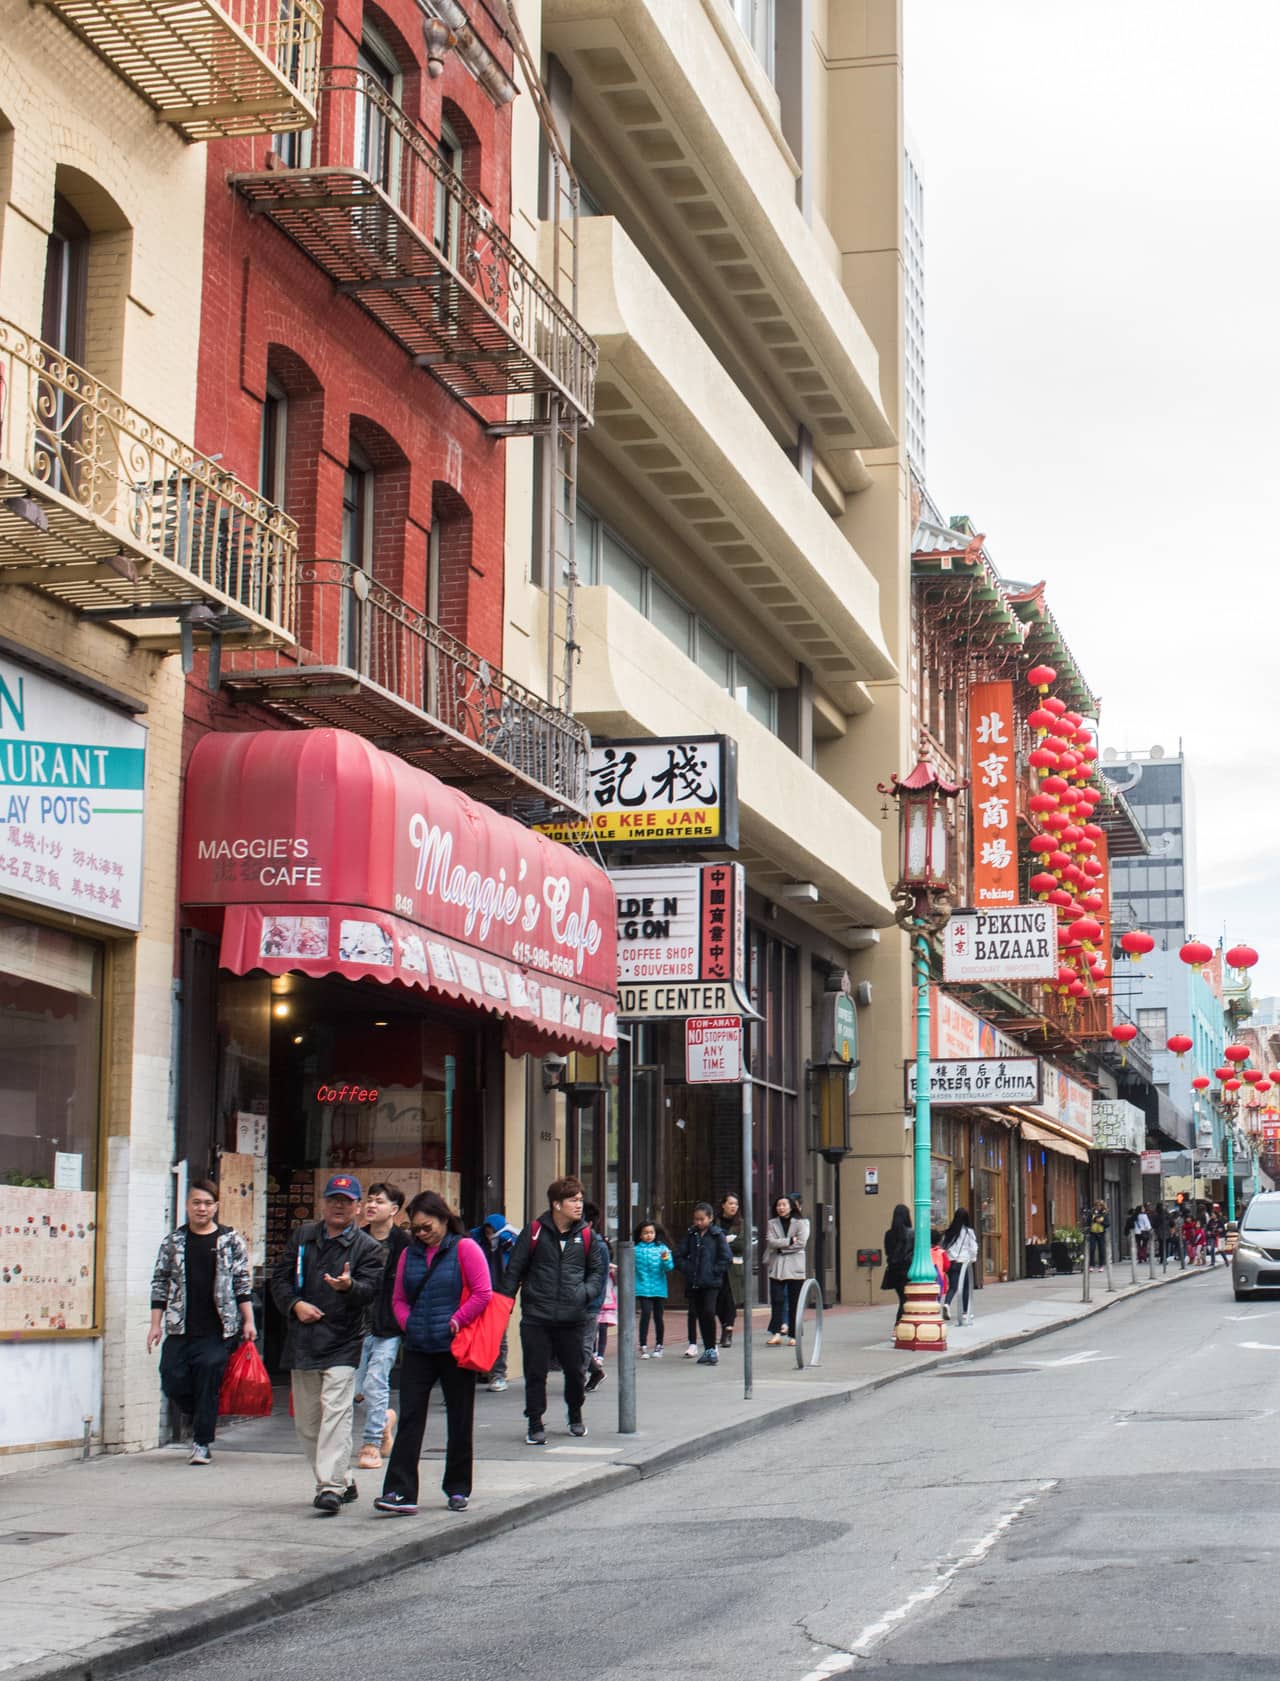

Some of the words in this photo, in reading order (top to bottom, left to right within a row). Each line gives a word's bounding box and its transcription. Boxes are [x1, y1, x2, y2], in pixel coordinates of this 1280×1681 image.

[976, 711, 1013, 870] 北京商場
[40, 795, 91, 825] POTS
[620, 813, 656, 827] KEE
[667, 811, 706, 826] JAN
[544, 830, 616, 841] HOLESALE
[629, 826, 713, 837] IMPORTERS
[198, 838, 309, 859] MAGGIE'S
[260, 866, 323, 886] CAFE
[409, 813, 540, 942] Maggie's
[543, 876, 602, 975] Cafe
[979, 888, 1015, 901] Peking
[395, 894, 413, 916] 848
[975, 912, 1047, 935] PEKING
[954, 924, 967, 954] 北京
[622, 948, 662, 961] COFFEE
[666, 946, 695, 959] SHOP
[974, 939, 1050, 961] BAZAAR
[634, 962, 695, 976] SOUVENIRS
[655, 987, 726, 1010] CENTER
[691, 1018, 736, 1028] TOW-AWAY
[688, 1028, 702, 1044] NO
[704, 1030, 738, 1042] STOPPING
[704, 1045, 724, 1057] ANY
[703, 1058, 725, 1070] TIME
[911, 1076, 971, 1091] EPRESS
[975, 1075, 991, 1090] OF
[994, 1075, 1036, 1090] CHINA
[316, 1085, 379, 1104] Coffee
